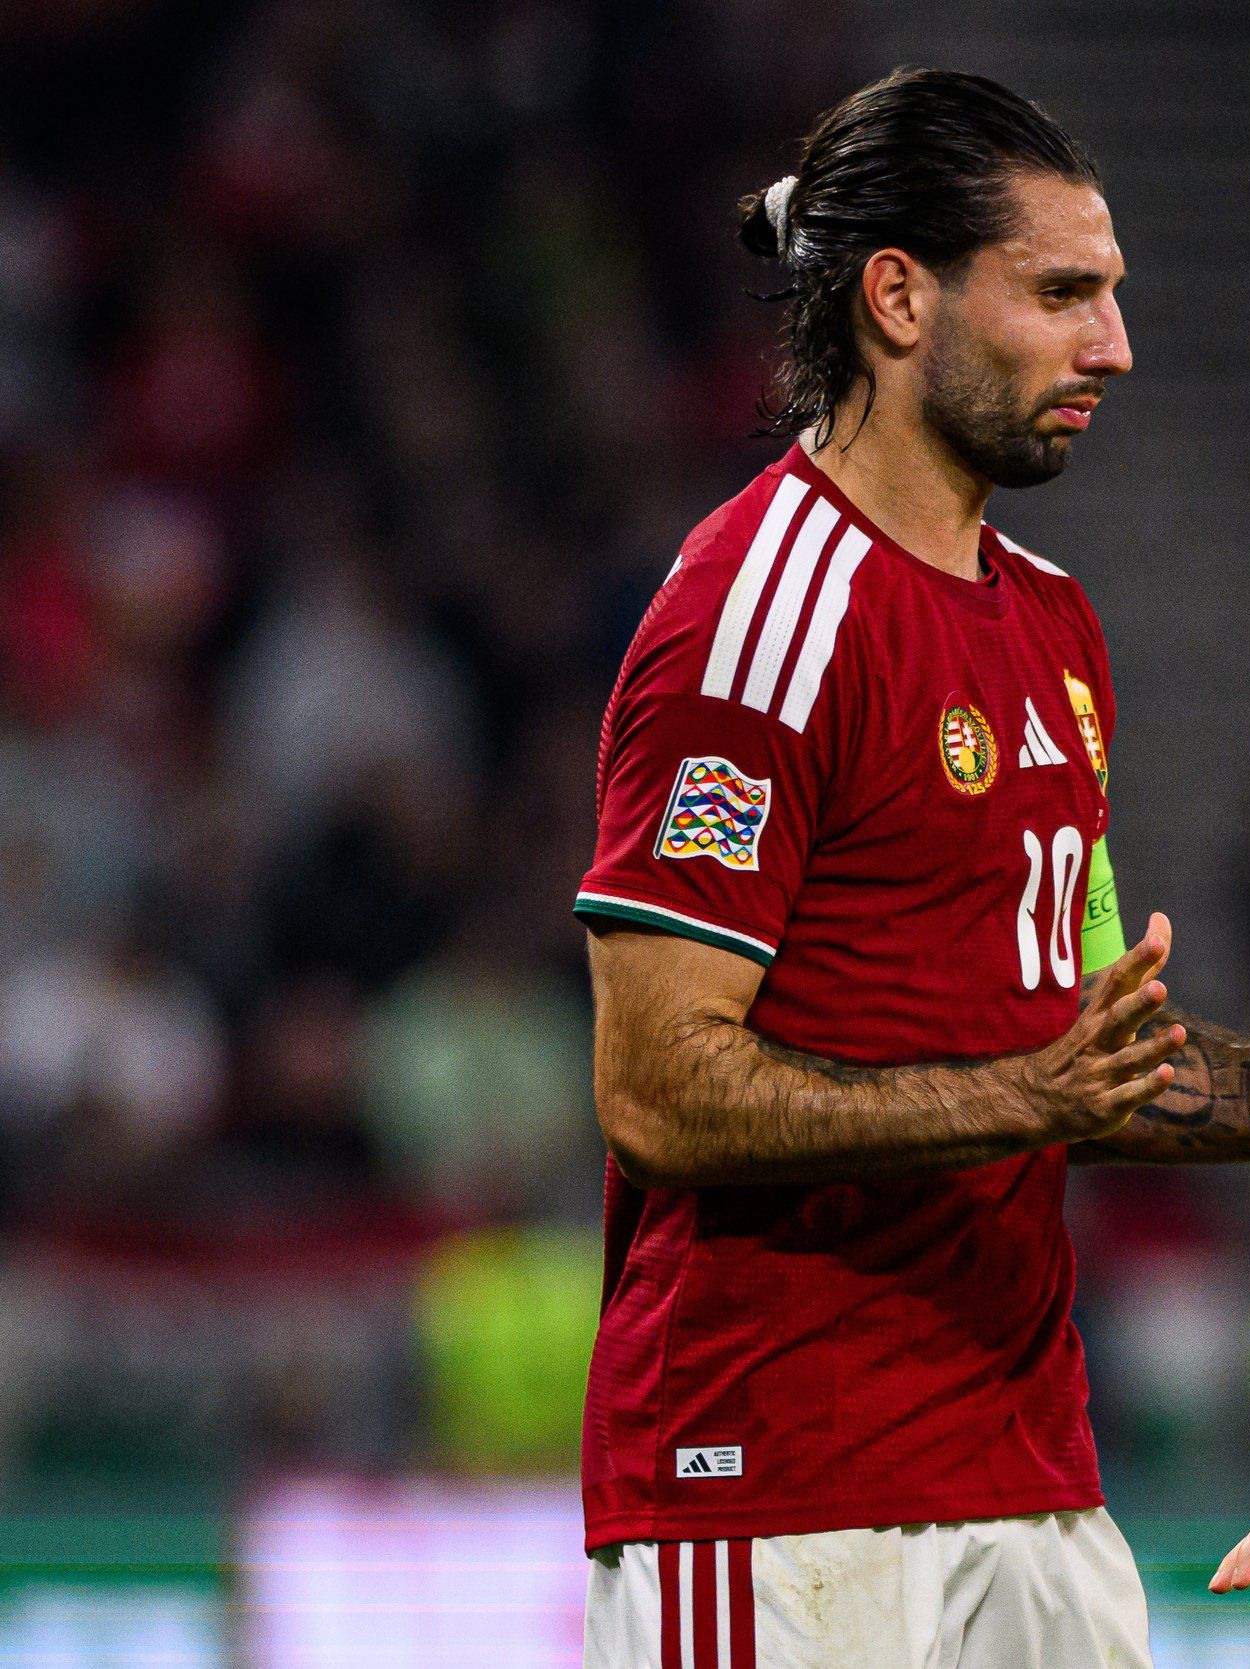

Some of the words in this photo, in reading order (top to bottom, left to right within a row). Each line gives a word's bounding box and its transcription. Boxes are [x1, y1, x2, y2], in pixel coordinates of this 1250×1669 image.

[966, 782, 986, 796] 125
[1017, 826, 1083, 991] 10
[1087, 887, 1115, 920] EC
